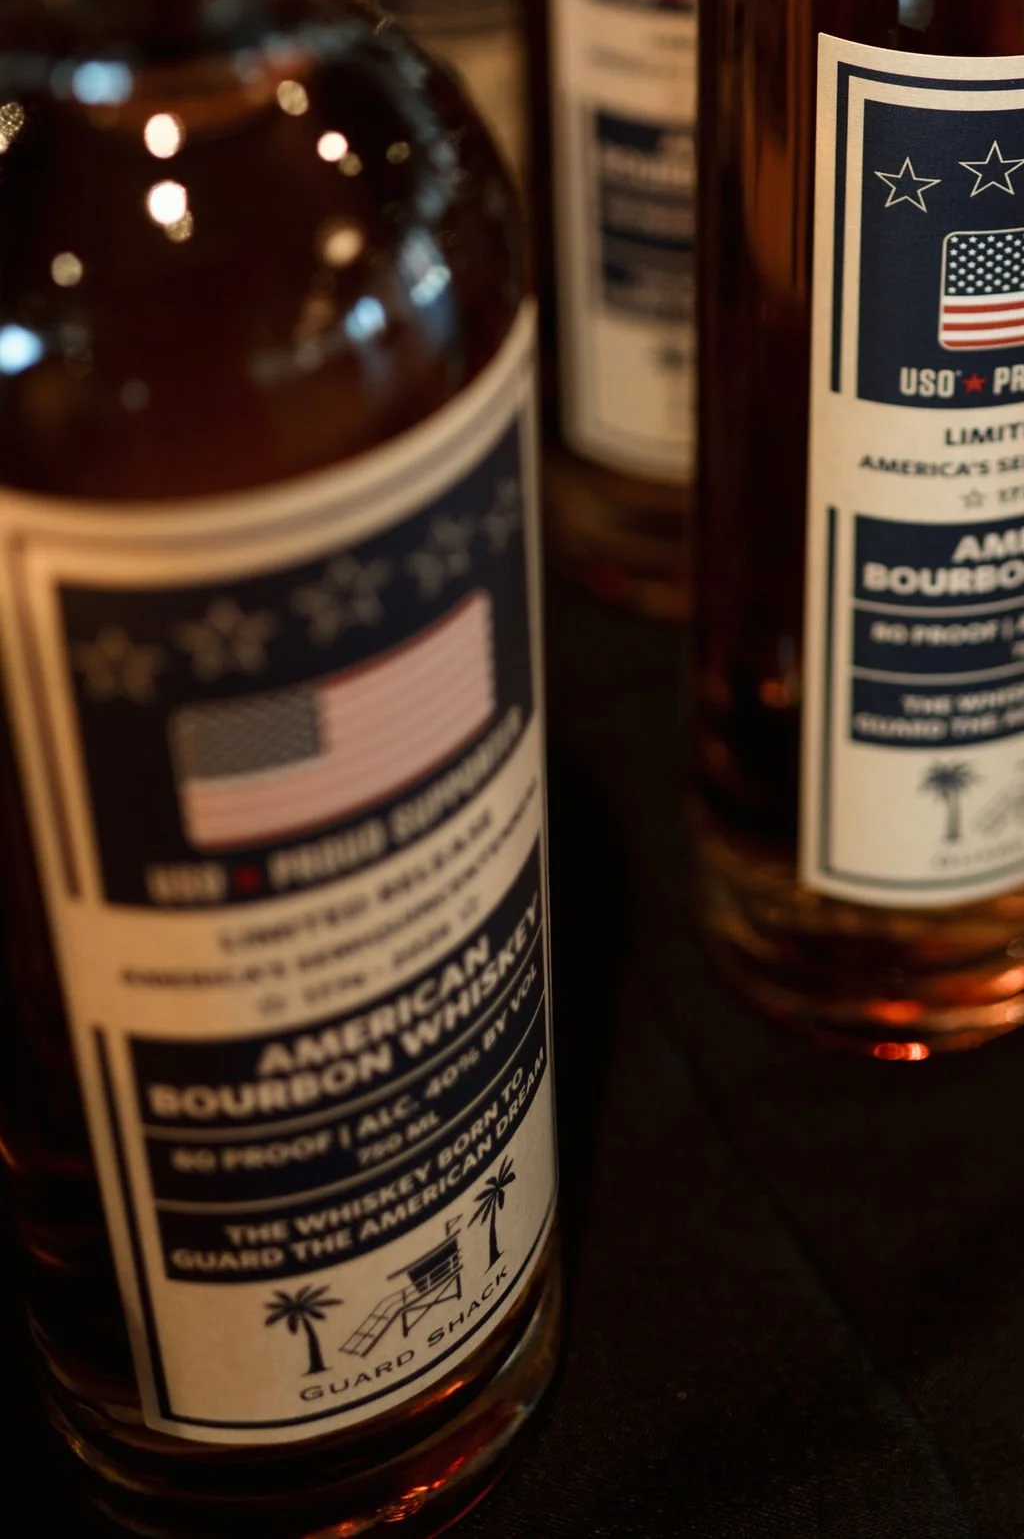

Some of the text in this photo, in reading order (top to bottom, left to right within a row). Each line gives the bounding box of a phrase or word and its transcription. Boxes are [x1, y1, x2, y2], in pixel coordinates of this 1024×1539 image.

[900, 367, 955, 397] USO
[859, 454, 990, 477] AMERICA'S
[147, 890, 540, 1117] BOURBON WHISKEY
[221, 1128, 334, 1171] PROOF
[424, 1048, 480, 1099] 40%
[483, 1015, 508, 1051] BY
[511, 963, 538, 1014] VOL
[256, 935, 492, 1077] AMERICAN
[170, 1045, 546, 1273] GUARD THE AMERICAN DREAM
[224, 1066, 524, 1248] THE WHISKEY BORN TO
[406, 1111, 440, 1144] ML
[300, 1265, 508, 1401] GUARD SHACK
